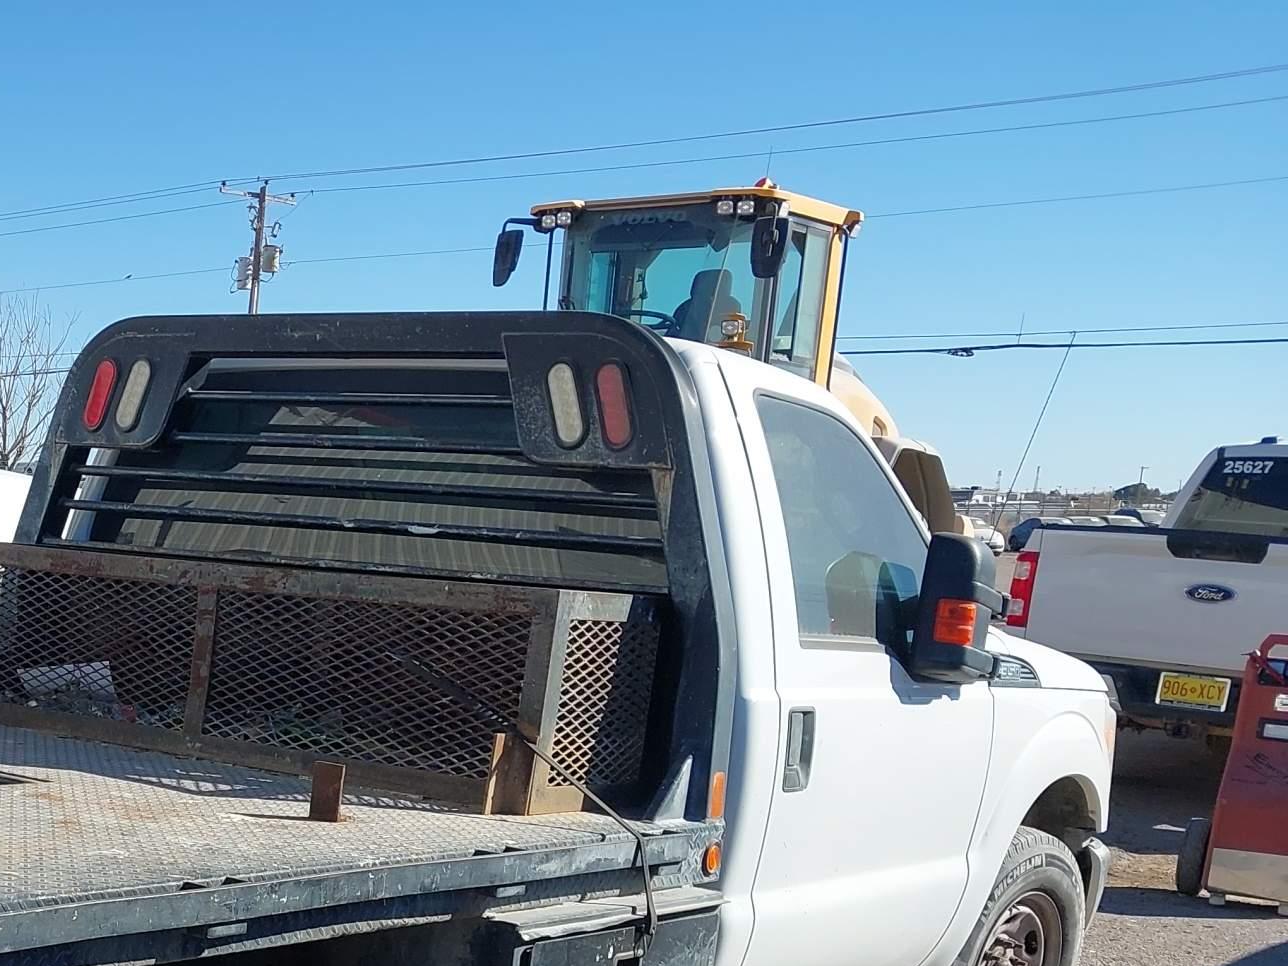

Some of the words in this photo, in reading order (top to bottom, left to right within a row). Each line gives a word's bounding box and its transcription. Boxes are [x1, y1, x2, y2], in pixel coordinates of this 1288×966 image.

[1223, 461, 1274, 474] 25627
[1194, 587, 1225, 600] Ford
[993, 855, 1042, 901] MICHELIN
